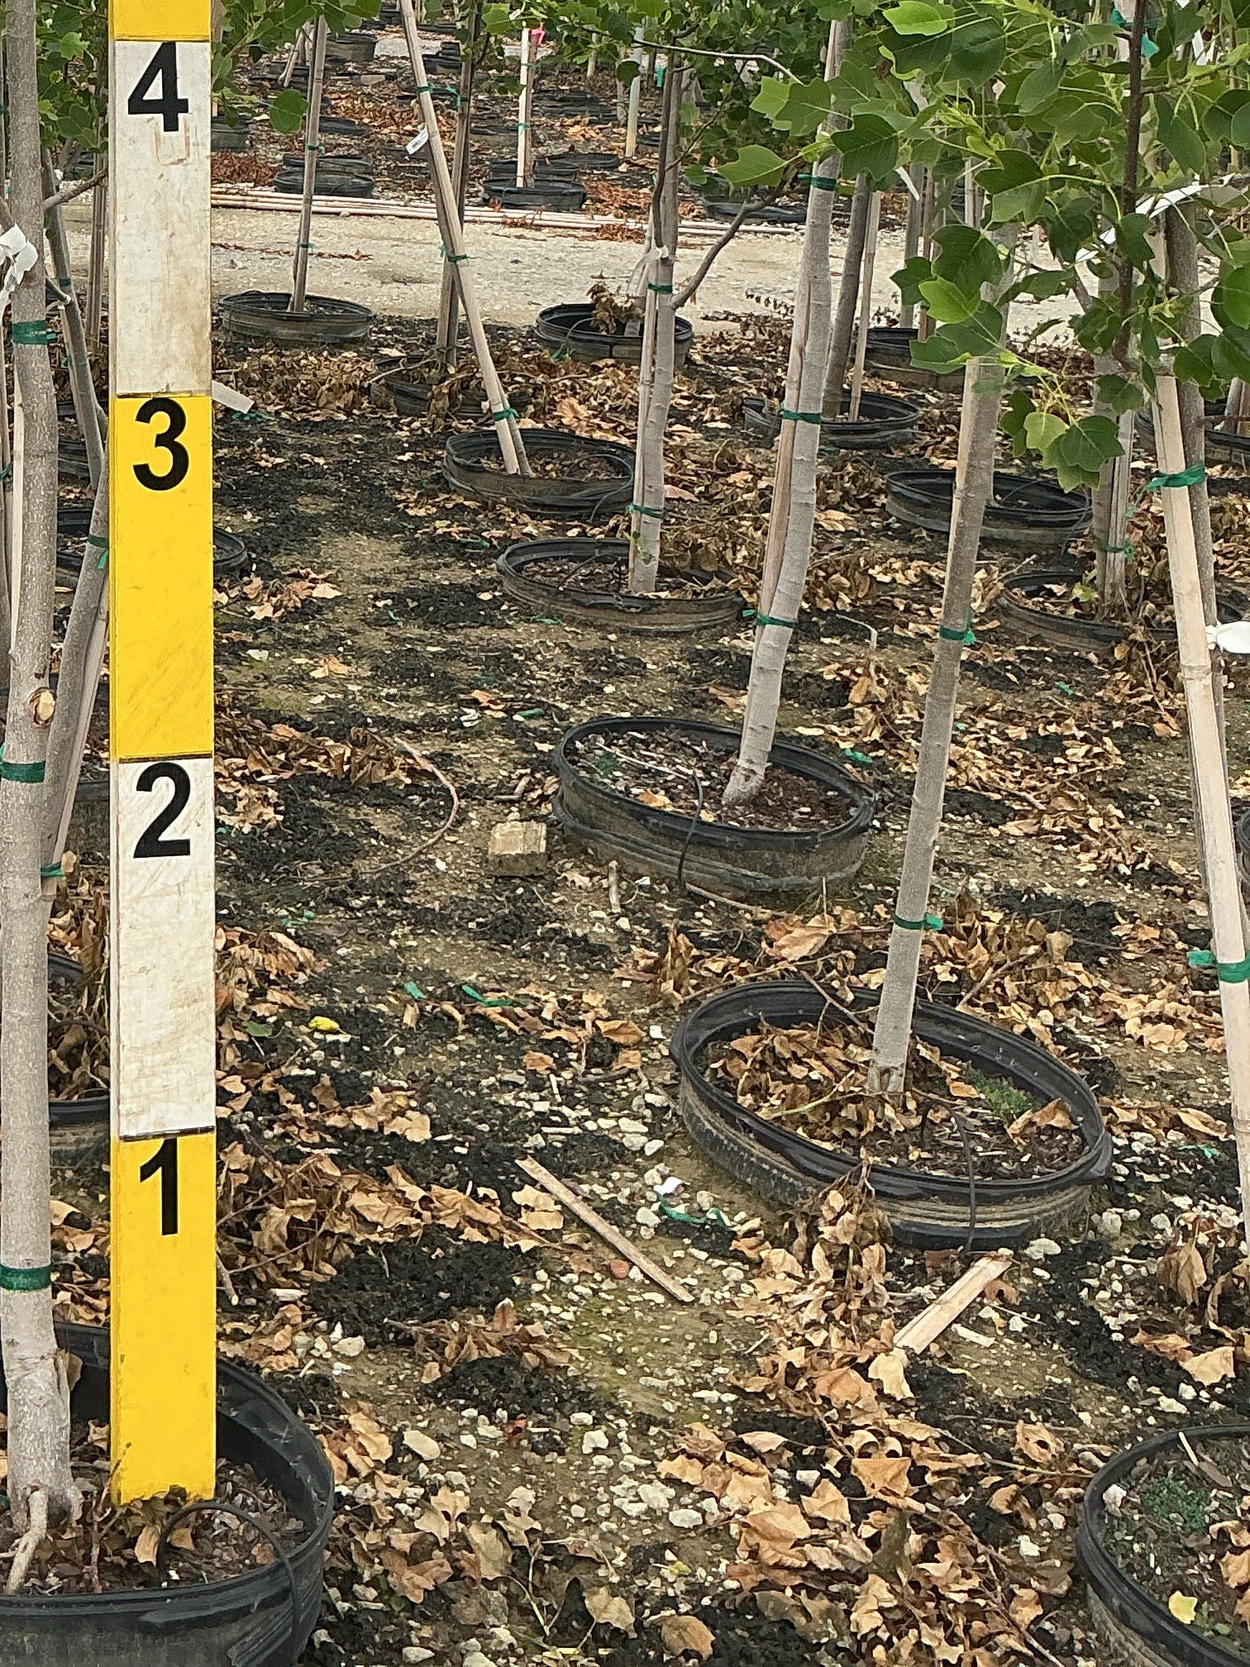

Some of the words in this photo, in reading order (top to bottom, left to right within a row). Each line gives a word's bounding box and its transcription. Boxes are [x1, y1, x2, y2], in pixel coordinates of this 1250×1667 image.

[128, 43, 189, 132] 4
[133, 398, 189, 491] 3
[132, 764, 191, 859] 2
[140, 1139, 178, 1236] 1
